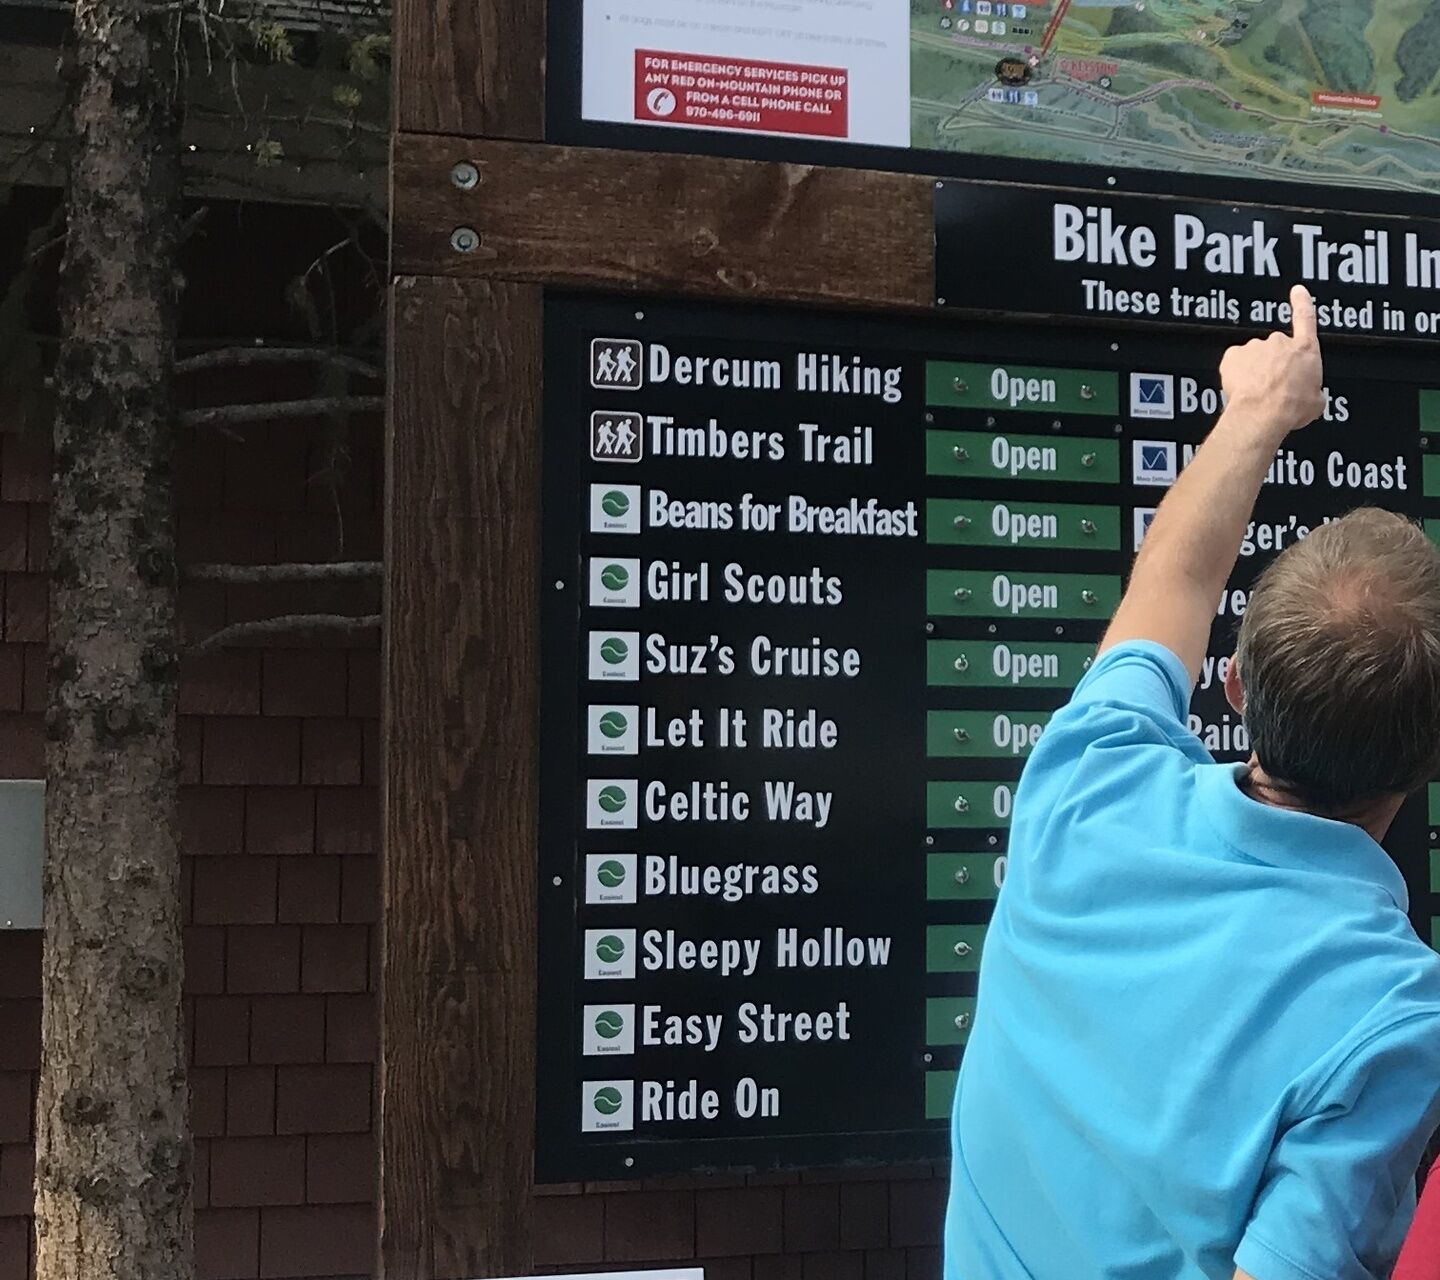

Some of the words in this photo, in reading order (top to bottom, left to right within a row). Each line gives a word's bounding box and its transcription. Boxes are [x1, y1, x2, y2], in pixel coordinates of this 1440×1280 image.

[645, 57, 669, 70] FOR
[671, 60, 740, 76] EMERGENCY
[744, 67, 798, 81] SERVICES
[801, 73, 827, 85] PICK
[830, 74, 846, 86] UP
[672, 75, 695, 86] RED
[697, 78, 780, 95] ON-MOUNTAIN
[783, 85, 822, 99] PHONE
[825, 89, 841, 100] OR
[686, 91, 719, 105] FROM
[732, 94, 759, 107] CELL
[762, 98, 801, 111] PHONE
[804, 102, 832, 114] CALL
[1054, 204, 1156, 267] Bike
[1175, 214, 1280, 276] Park
[1293, 224, 1388, 284] Trail
[1082, 280, 1160, 314] These
[1171, 283, 1240, 322] trails
[1250, 298, 1292, 323] are
[1384, 302, 1404, 331] in
[650, 344, 780, 389] Dercum
[798, 353, 901, 402] Hiking
[991, 368, 1055, 407] Open
[1180, 376, 1228, 416] Bo
[647, 416, 784, 460] Timbers
[799, 424, 872, 464] Trail
[992, 437, 1056, 476] Open
[1328, 452, 1407, 489] Coast
[650, 490, 733, 529] Beans
[739, 493, 781, 531] for
[789, 496, 918, 536] Breakfast
[992, 505, 1056, 543] Open
[648, 561, 708, 601] Girl
[725, 563, 842, 604] Scouts
[993, 575, 1057, 614] Open
[647, 633, 734, 674] Suz's
[751, 636, 859, 676] Cruise
[993, 645, 1058, 683] Open
[647, 708, 703, 747] Let
[720, 709, 746, 747] It
[764, 709, 837, 748] Ride
[993, 714, 1045, 754] Ope
[646, 781, 749, 821] Celtic
[765, 782, 832, 828] Way
[646, 856, 818, 901] Bluegrass
[643, 930, 760, 976] Sleepy
[778, 928, 890, 967] Hollow
[643, 1006, 722, 1051] Easy
[739, 1003, 850, 1043] Street
[642, 1080, 719, 1121] Ride
[736, 1078, 778, 1118] On
